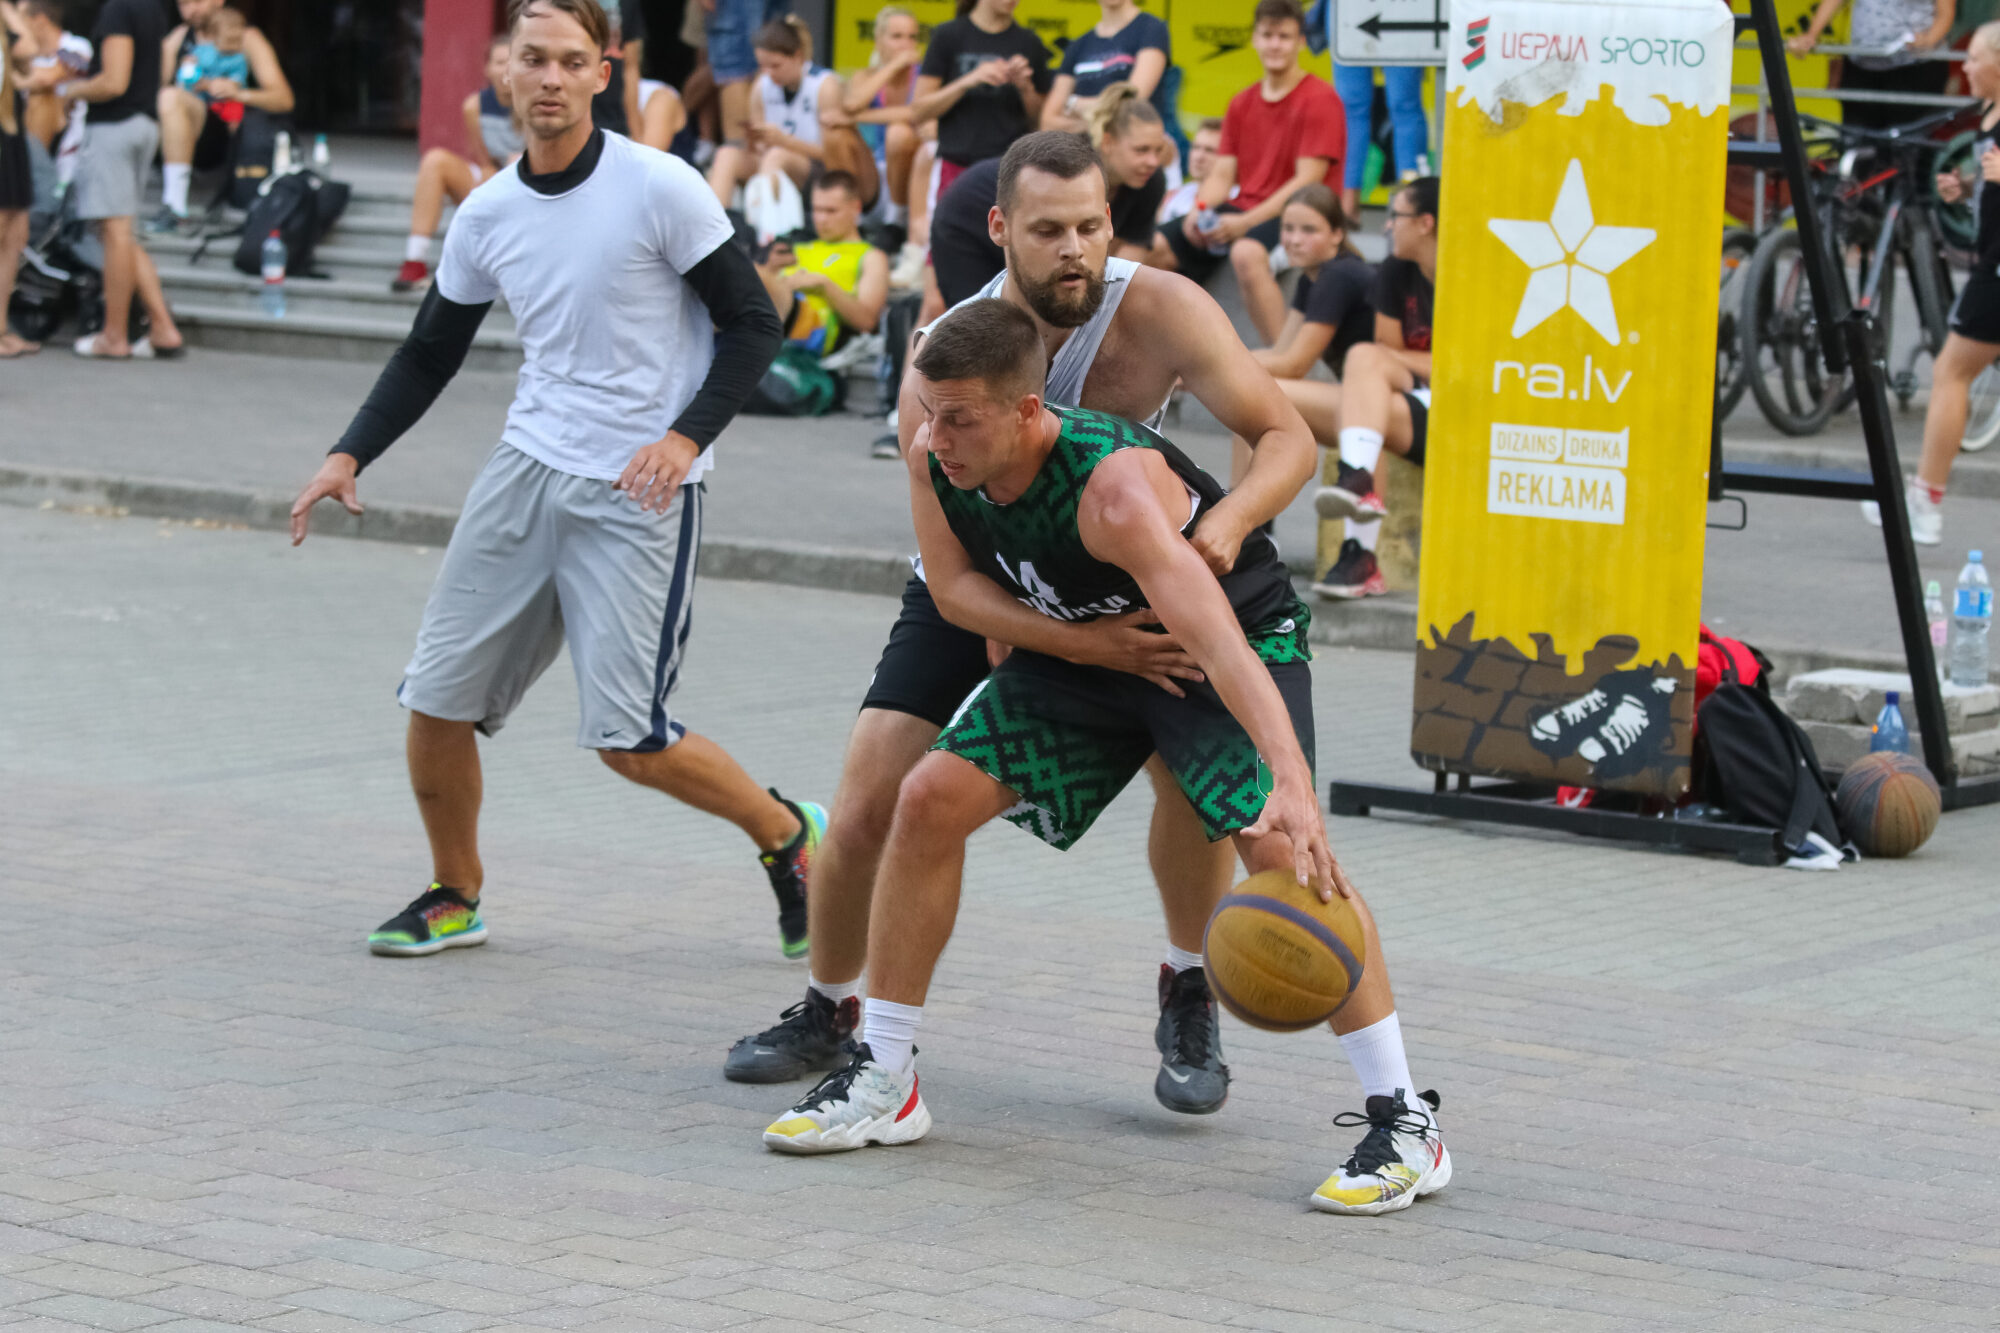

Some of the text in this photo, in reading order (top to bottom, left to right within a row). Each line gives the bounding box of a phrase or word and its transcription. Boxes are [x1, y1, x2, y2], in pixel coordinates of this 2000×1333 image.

[1601, 36, 1705, 68] SPORTO
[1493, 355, 1633, 403] ra.lv
[1497, 431, 1622, 460] DIZAINS DRUKA
